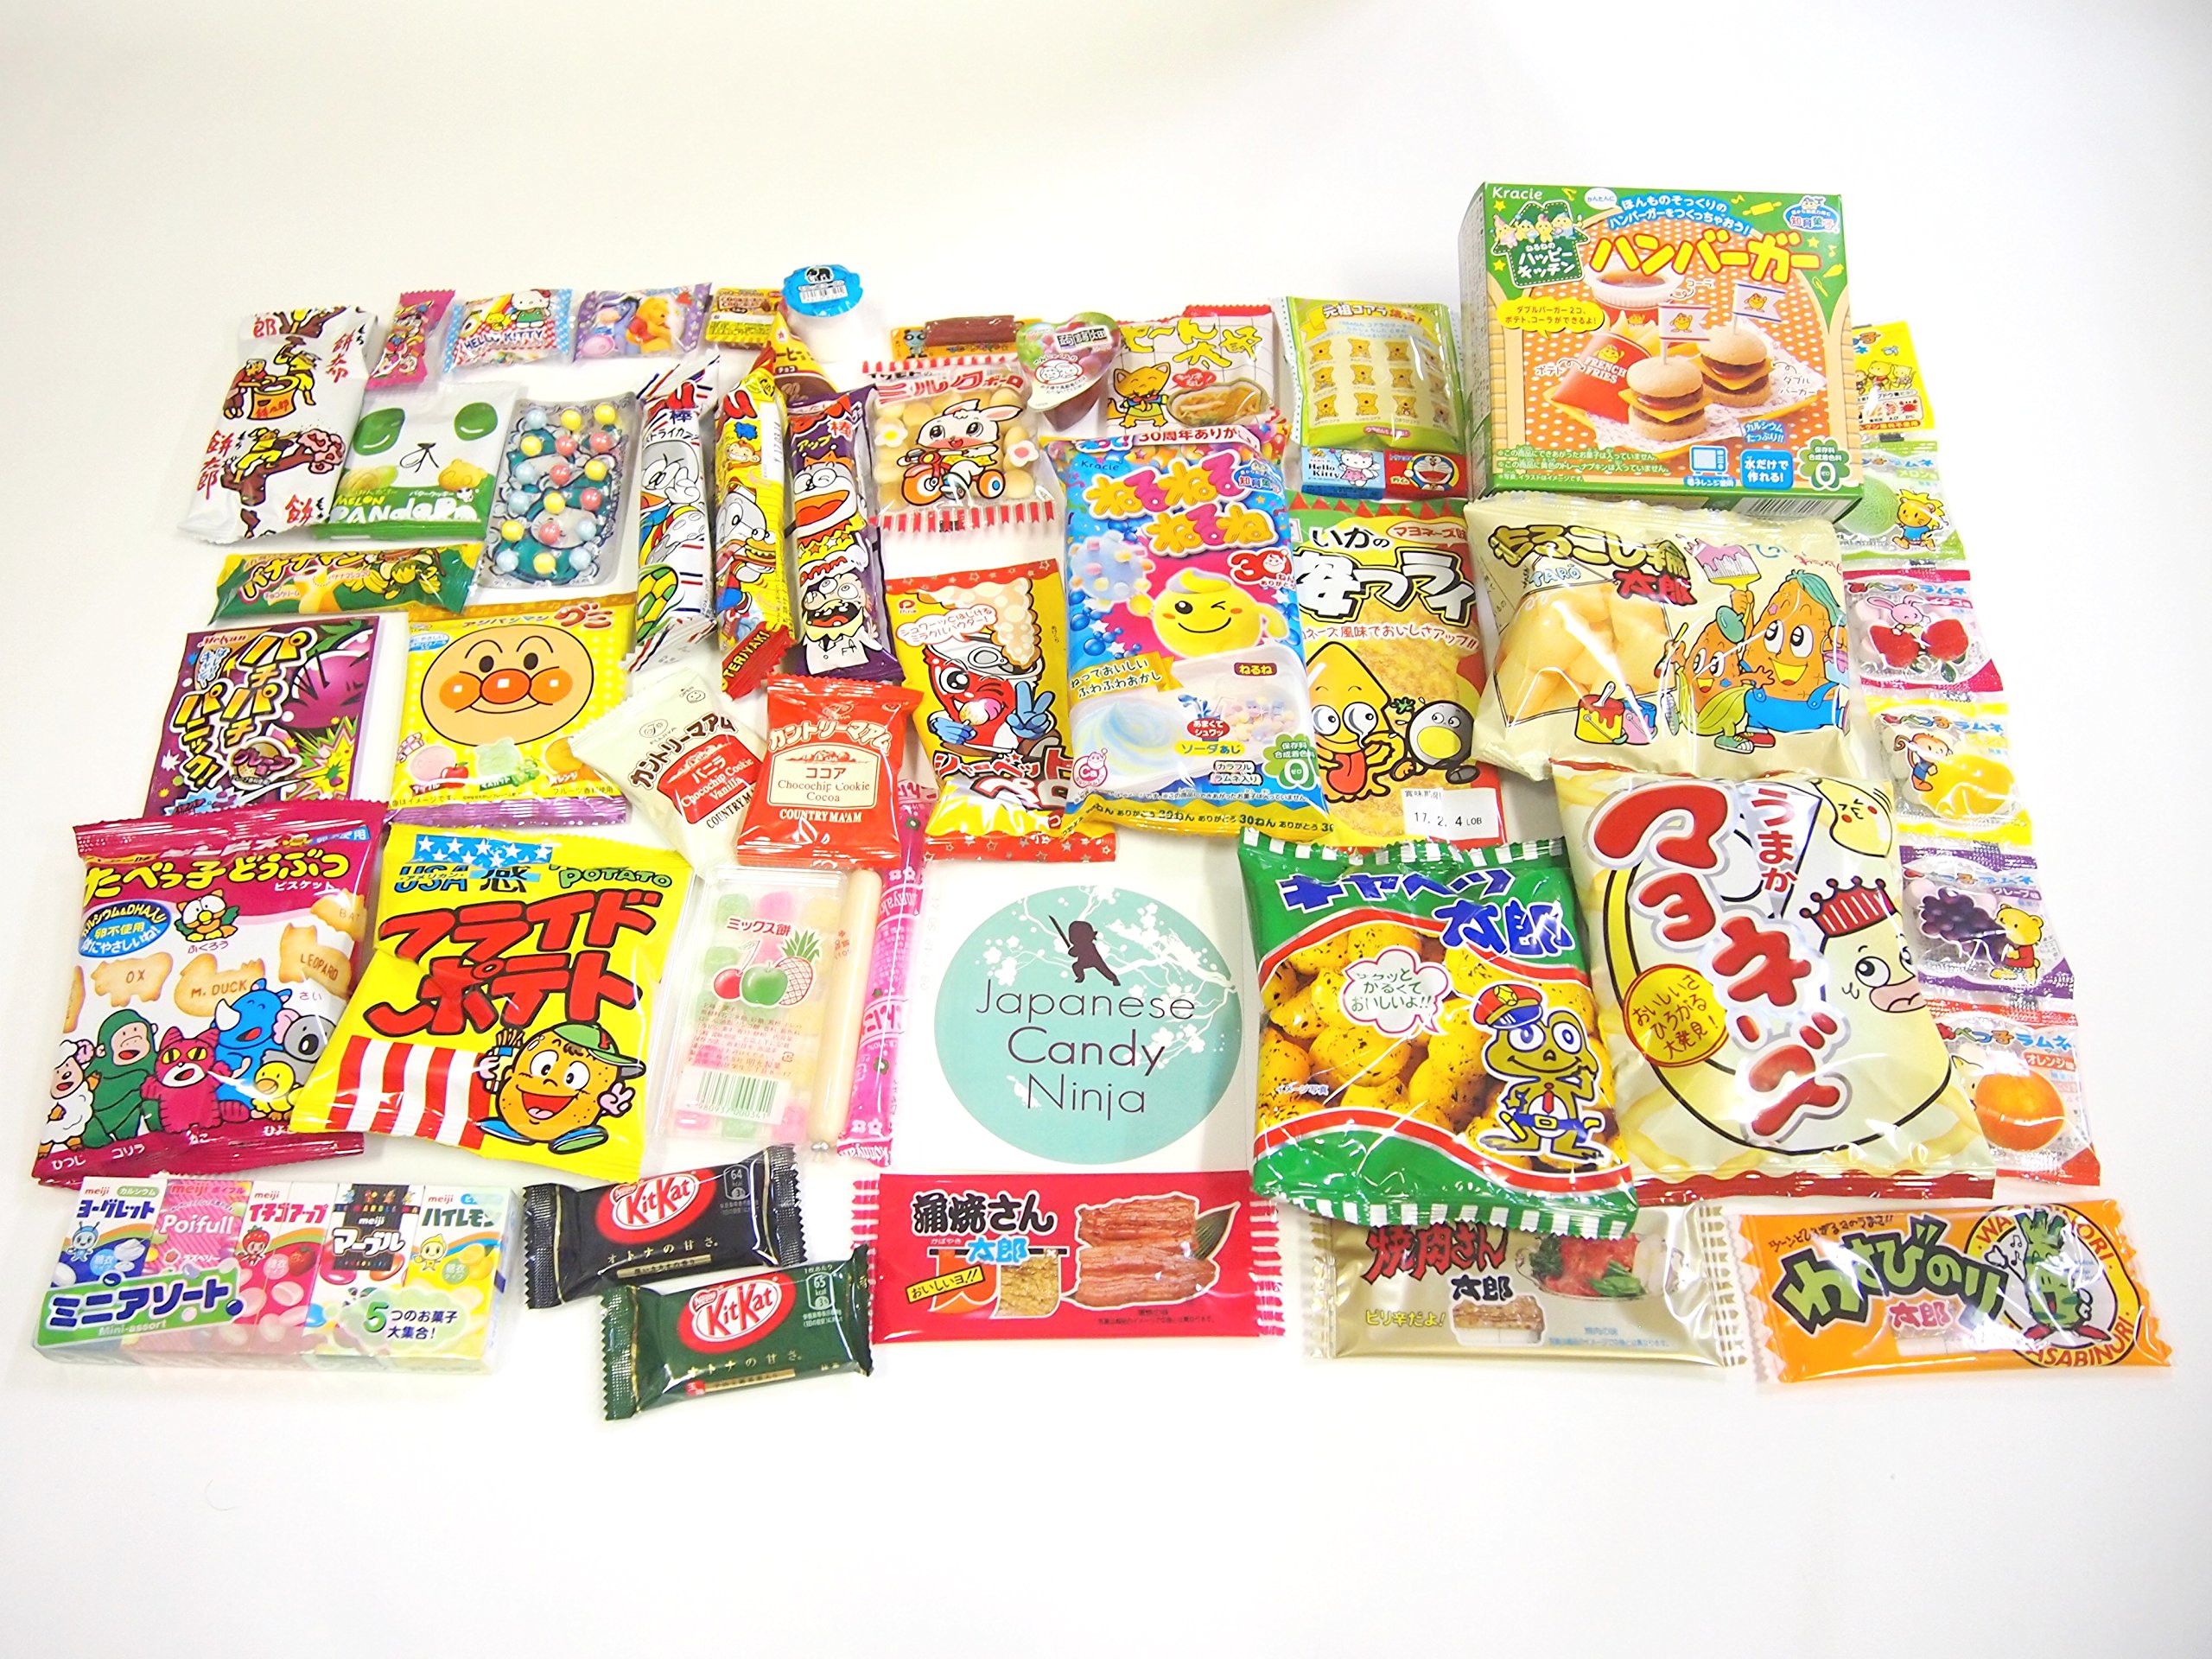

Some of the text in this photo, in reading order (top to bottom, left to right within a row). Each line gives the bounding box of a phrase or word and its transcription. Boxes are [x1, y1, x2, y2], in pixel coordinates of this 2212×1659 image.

[1492, 187, 1543, 201] Kracie
[1621, 195, 1727, 213] ほんものそっくりの
[1519, 249, 1573, 265] ハッピー
[1590, 229, 1822, 283] ハンバーガー
[1517, 262, 1576, 277] キッチン
[1687, 278, 1714, 289] コーラ
[504, 330, 543, 343] KITTY
[1535, 365, 1562, 377] ポテト
[1583, 356, 1627, 378] FRENCH
[1585, 365, 1618, 385] FRIES
[1784, 376, 1811, 386] ダブル
[1745, 422, 1784, 434] カルシウム
[1081, 460, 1120, 472] Kracie
[1744, 459, 1789, 471] 水だけで
[1084, 451, 1248, 517] ねるねる
[1313, 471, 1341, 480] Kitty
[334, 494, 385, 506] MELON
[1147, 503, 1275, 554] ねるね
[1311, 527, 1391, 549] いかの
[1612, 569, 1698, 607] 太郎
[554, 601, 613, 629] グミ
[724, 631, 772, 680] TERIYAKI
[1071, 661, 1149, 689] ねっておいしい
[1238, 664, 1273, 676] ねるね
[1078, 671, 1162, 698] ふわふわおかし
[1192, 720, 1225, 728] あまくて
[768, 721, 893, 755] カントリーマアム
[1281, 742, 1307, 751] 保存料
[1180, 744, 1241, 755] ソーダあじ
[692, 755, 727, 782] バニラ
[804, 766, 847, 780] ココア
[1080, 765, 1097, 778] Ca
[1216, 762, 1252, 772] カラフル
[681, 757, 755, 807] Chocochip Cookie
[709, 776, 743, 801] Vanilla
[834, 779, 870, 792] Cookie
[1211, 773, 1260, 785] ラムネ入り
[806, 791, 841, 804] Cocoa
[706, 799, 744, 830] COUNTRY
[779, 810, 862, 823] COUNTRY MA'AM
[1239, 814, 1276, 828] 30ねん
[1279, 821, 1319, 831] ありがとう
[1751, 788, 1798, 893] うまか
[85, 848, 350, 904] たべっ子どうぶつ
[558, 866, 673, 889] POTATO
[274, 880, 340, 896] ビスケット
[95, 921, 146, 940] 卵不使用
[379, 889, 664, 963] フライド
[727, 918, 794, 938] ミックス餅
[1434, 898, 1575, 956] 太郎
[188, 940, 230, 954] ふくろう
[125, 969, 146, 983] OX
[301, 954, 339, 982] LEOPARD
[212, 980, 248, 996] DUCK
[299, 990, 323, 1001] さい
[363, 950, 644, 1036] ポテト
[1363, 980, 1423, 995] かるくて
[976, 978, 1196, 1024] Japanese
[1649, 993, 1707, 1041] ひろがる
[1007, 1026, 1166, 1077] Candy
[1027, 1073, 1146, 1121] Ninja
[52, 1154, 87, 1170] ひつじ
[730, 1168, 743, 1180] 64
[85, 1186, 111, 1197] meiji
[172, 1184, 209, 1196] meiji
[254, 1190, 280, 1200] meiji
[428, 1194, 454, 1205] meiji
[626, 1174, 693, 1225] KitKat
[76, 1198, 156, 1220] ヨーグレット
[249, 1203, 329, 1224] イチゴアップ
[912, 1191, 1055, 1235] 蒲焼さん
[161, 1213, 235, 1236] Poifull
[359, 1216, 386, 1227] meiji
[332, 1227, 406, 1257] マーブル
[968, 1236, 1030, 1264] 太郎
[1360, 1221, 1509, 1285] 焼肉さん
[813, 1275, 827, 1288] 65
[1452, 1274, 1514, 1303] 太郎
[49, 1278, 230, 1328] ミニアソート
[705, 1282, 776, 1337] KitKat
[1888, 1301, 1948, 1329] 太郎
[98, 1319, 167, 1338] Mini-assort
